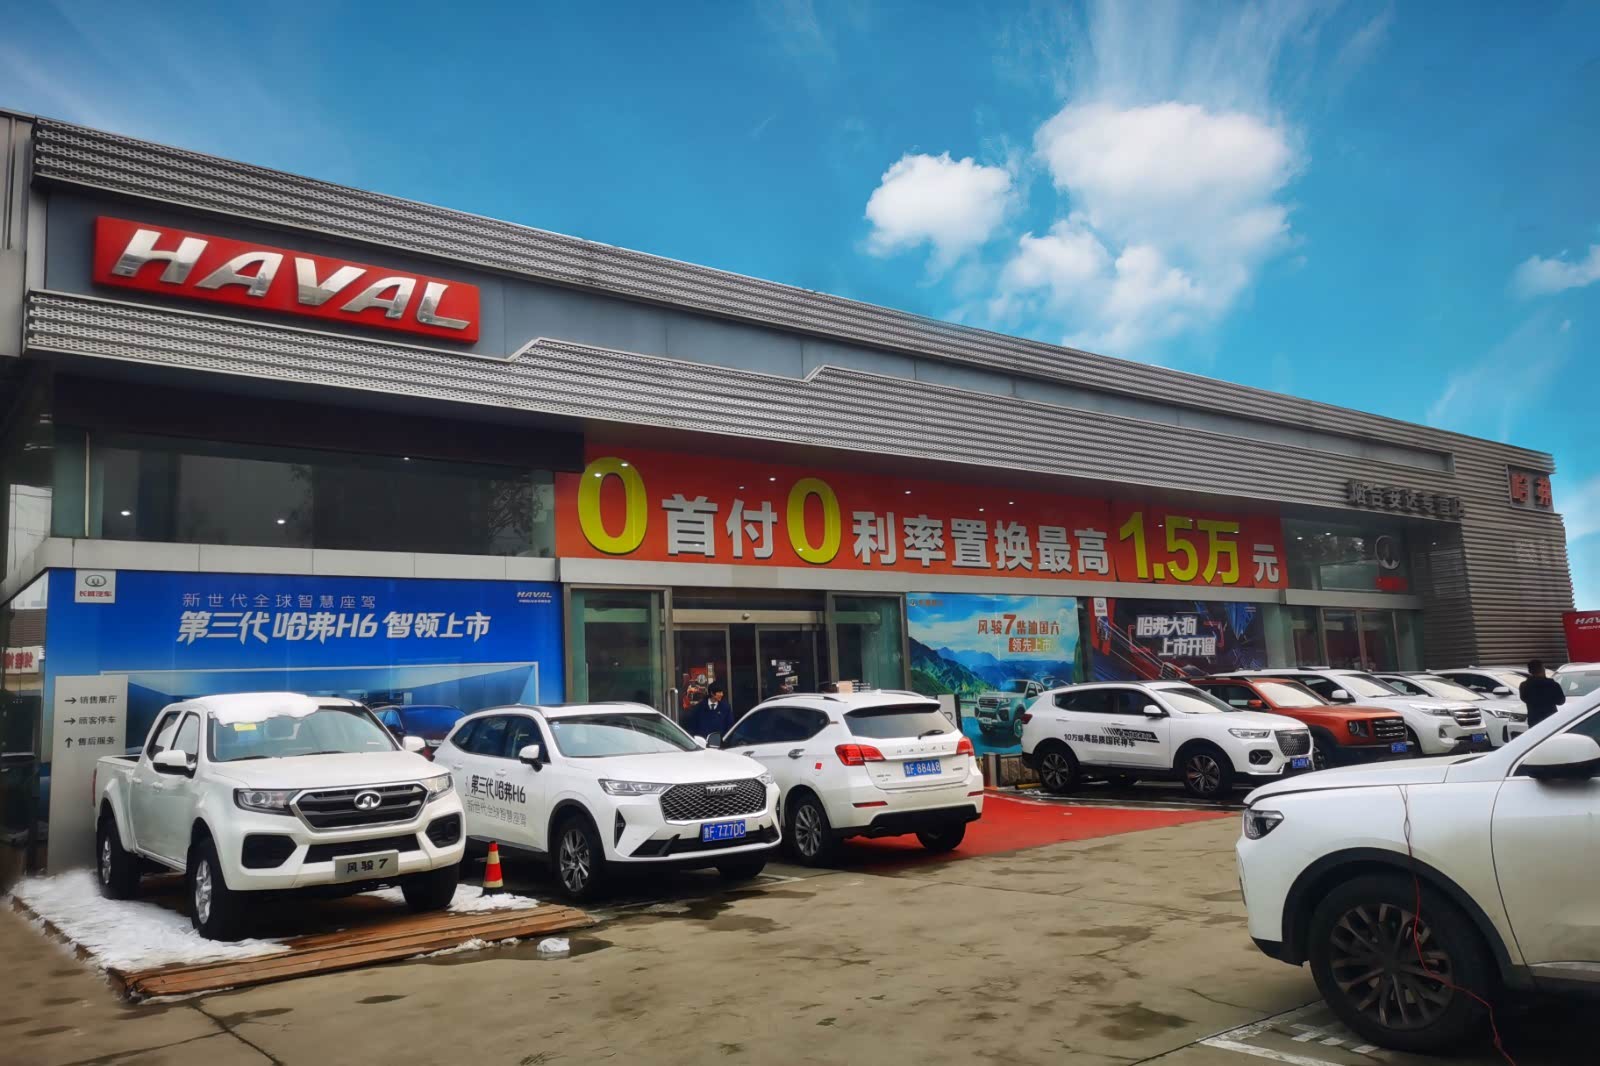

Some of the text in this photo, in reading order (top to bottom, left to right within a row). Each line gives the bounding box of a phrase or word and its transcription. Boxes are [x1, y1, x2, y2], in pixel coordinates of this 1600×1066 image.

[111, 228, 472, 330] HAVAL
[182, 592, 376, 609] 新世代全球智慧座驾
[516, 591, 553, 599] HAVAL
[1136, 616, 1198, 637] 哈弗大狗
[79, 695, 117, 705] 销售展厅
[77, 736, 116, 746] 售后服务
[471, 774, 526, 804] 第三代哈弗H6
